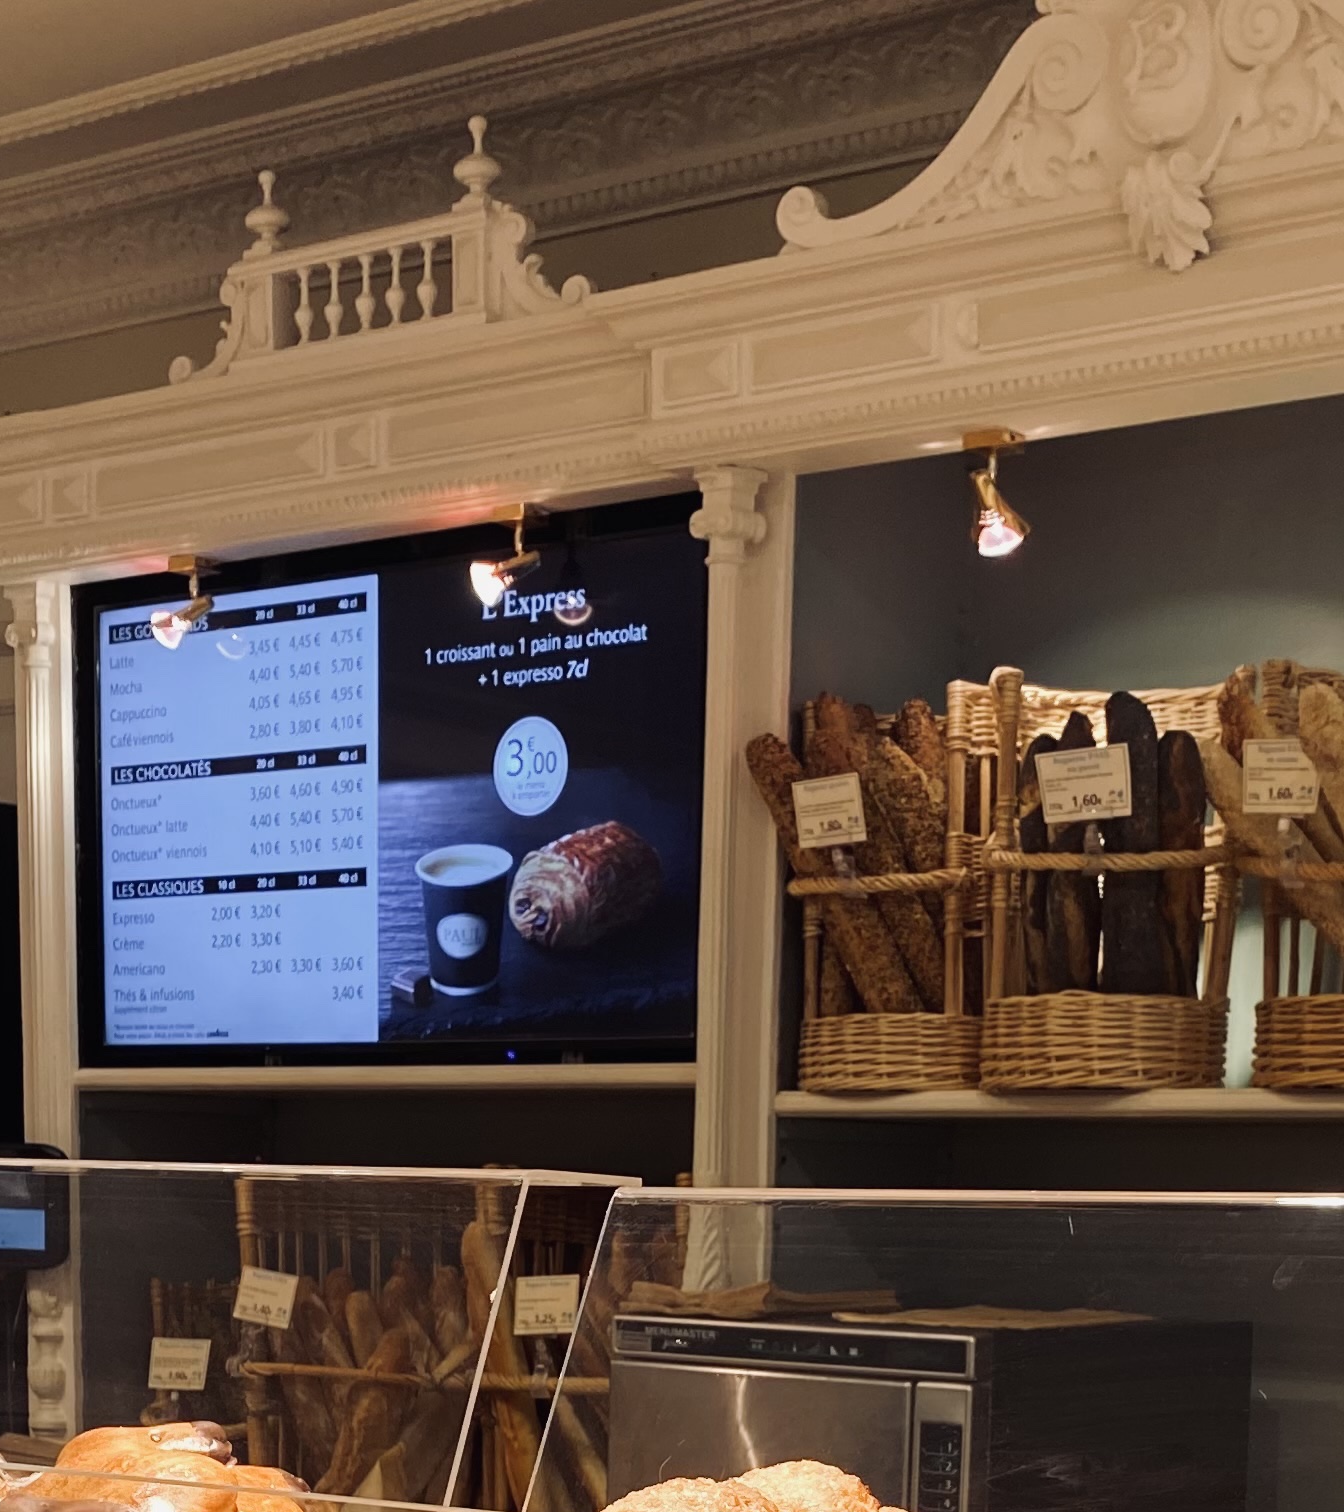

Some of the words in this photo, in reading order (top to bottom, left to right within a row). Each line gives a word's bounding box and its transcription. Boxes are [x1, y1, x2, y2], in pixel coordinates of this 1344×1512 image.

[113, 624, 132, 642] LES
[425, 648, 431, 665] 1
[436, 642, 496, 663] croissant
[499, 644, 514, 656] ou
[519, 637, 525, 654] 1
[530, 633, 561, 656] pain
[564, 634, 583, 649] au
[586, 624, 648, 647] chocolat
[109, 655, 134, 671] Latte
[491, 669, 498, 686] 1
[503, 666, 564, 688] expresso
[110, 681, 143, 696] Mocha
[110, 704, 168, 723] Cappuccino
[114, 768, 133, 783] LES
[136, 759, 212, 782] CHOCOLATÉS
[165, 819, 188, 832] latte
[166, 844, 207, 859] viennois
[116, 882, 135, 898] LES
[137, 879, 204, 897] CLASSIQUES
[113, 912, 155, 927] Expresso
[113, 937, 144, 951] Crème
[113, 962, 165, 977] Americano
[114, 989, 137, 1001] Thés
[139, 988, 147, 1000] &
[150, 987, 195, 1001] infusions
